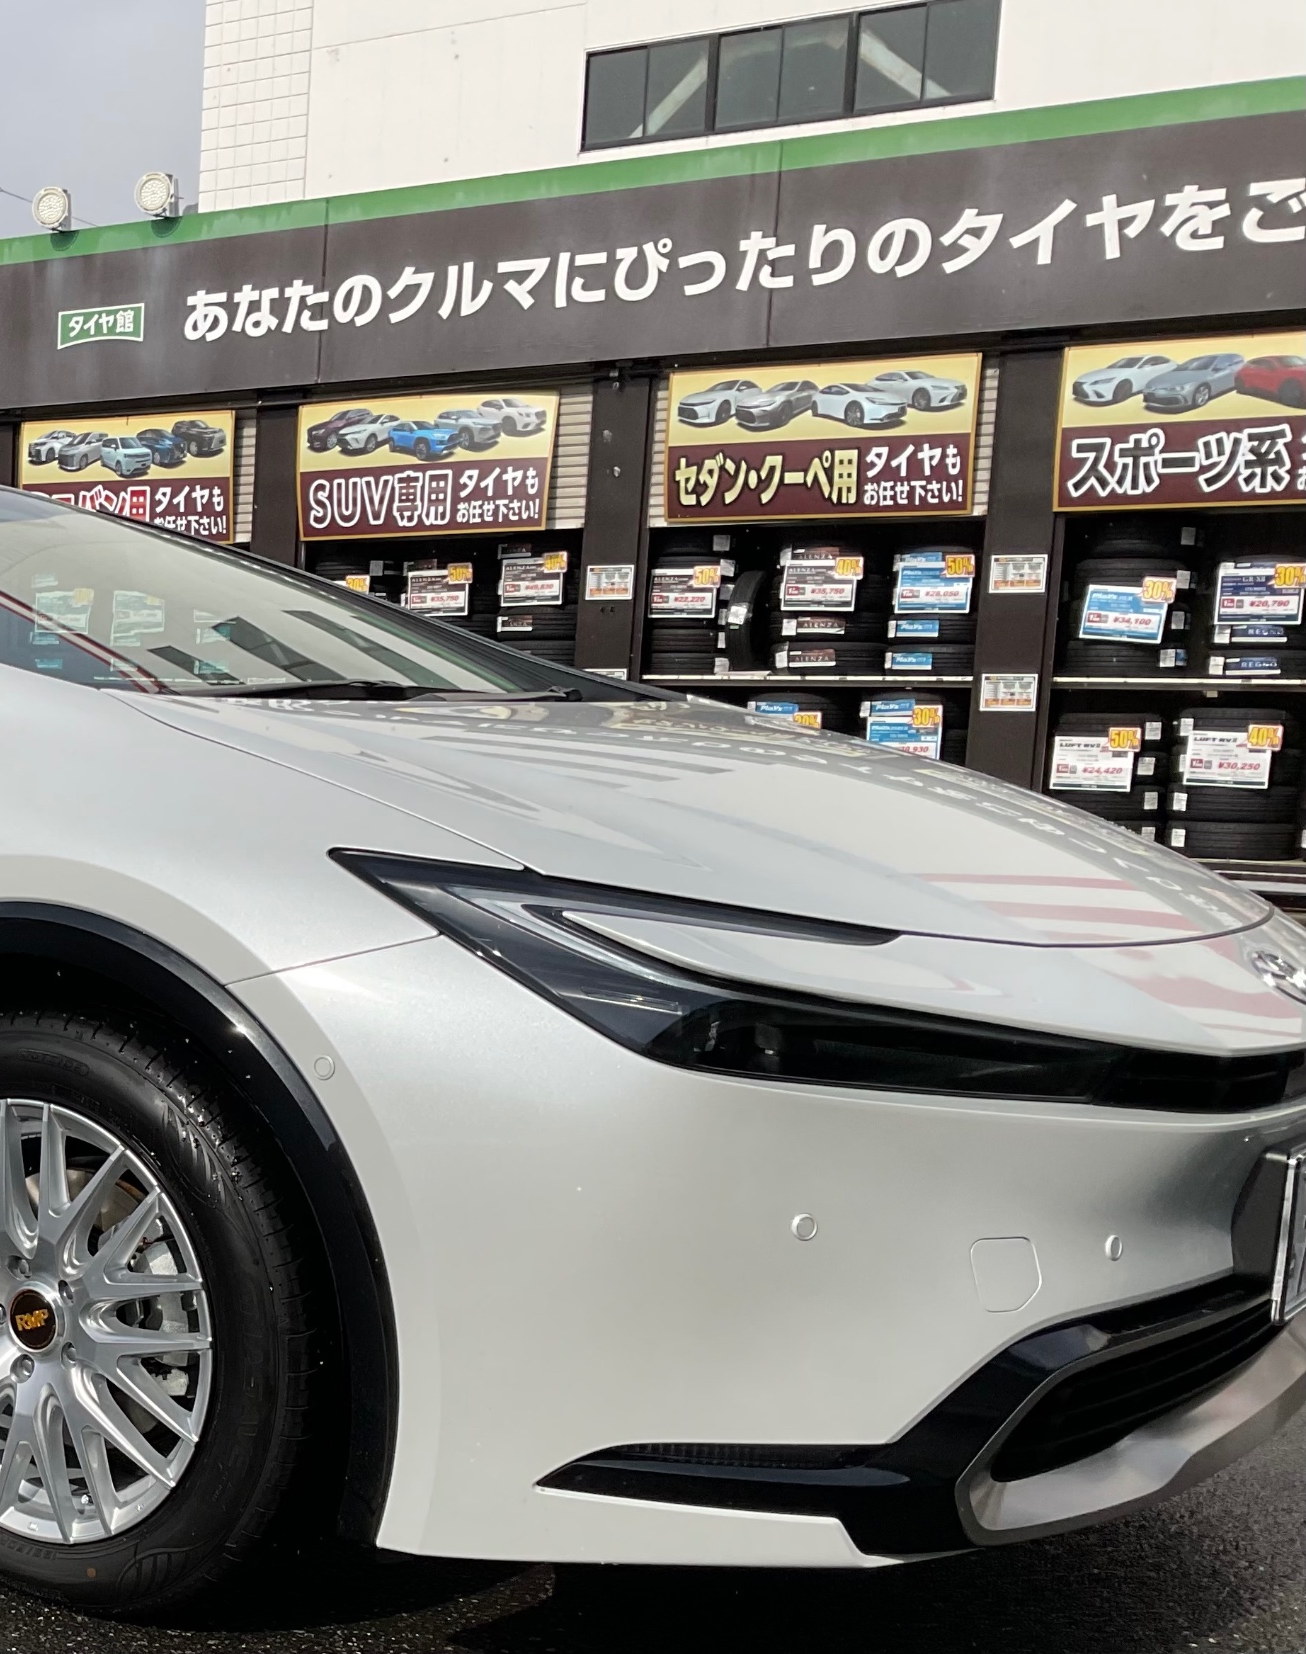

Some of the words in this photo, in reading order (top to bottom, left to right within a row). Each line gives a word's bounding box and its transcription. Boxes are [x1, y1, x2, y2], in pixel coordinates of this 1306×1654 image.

[183, 177, 1306, 342] あなたのクルマにぴったりのタイヤをご
[68, 309, 135, 338] タイヤ館
[865, 443, 962, 478] タイヤも
[1067, 423, 1293, 498] スポーツ系
[459, 466, 540, 499] タイヤも
[674, 448, 859, 507] セダン・クーペ用
[154, 484, 225, 514] タイヤも
[309, 469, 453, 530] SUV専用
[695, 567, 719, 586] 50%
[836, 558, 862, 576] 40%
[946, 556, 974, 576] 50%
[1275, 565, 1306, 587] 30%
[1143, 580, 1174, 601] 30%
[1113, 615, 1152, 626] ¥34,100
[913, 707, 941, 726] 30%
[1110, 729, 1139, 749] 50%
[1248, 727, 1280, 747] 40%
[1082, 766, 1123, 775] ¥24,420
[1218, 761, 1261, 770] ¥30,250
[15, 1308, 49, 1331] RMP
